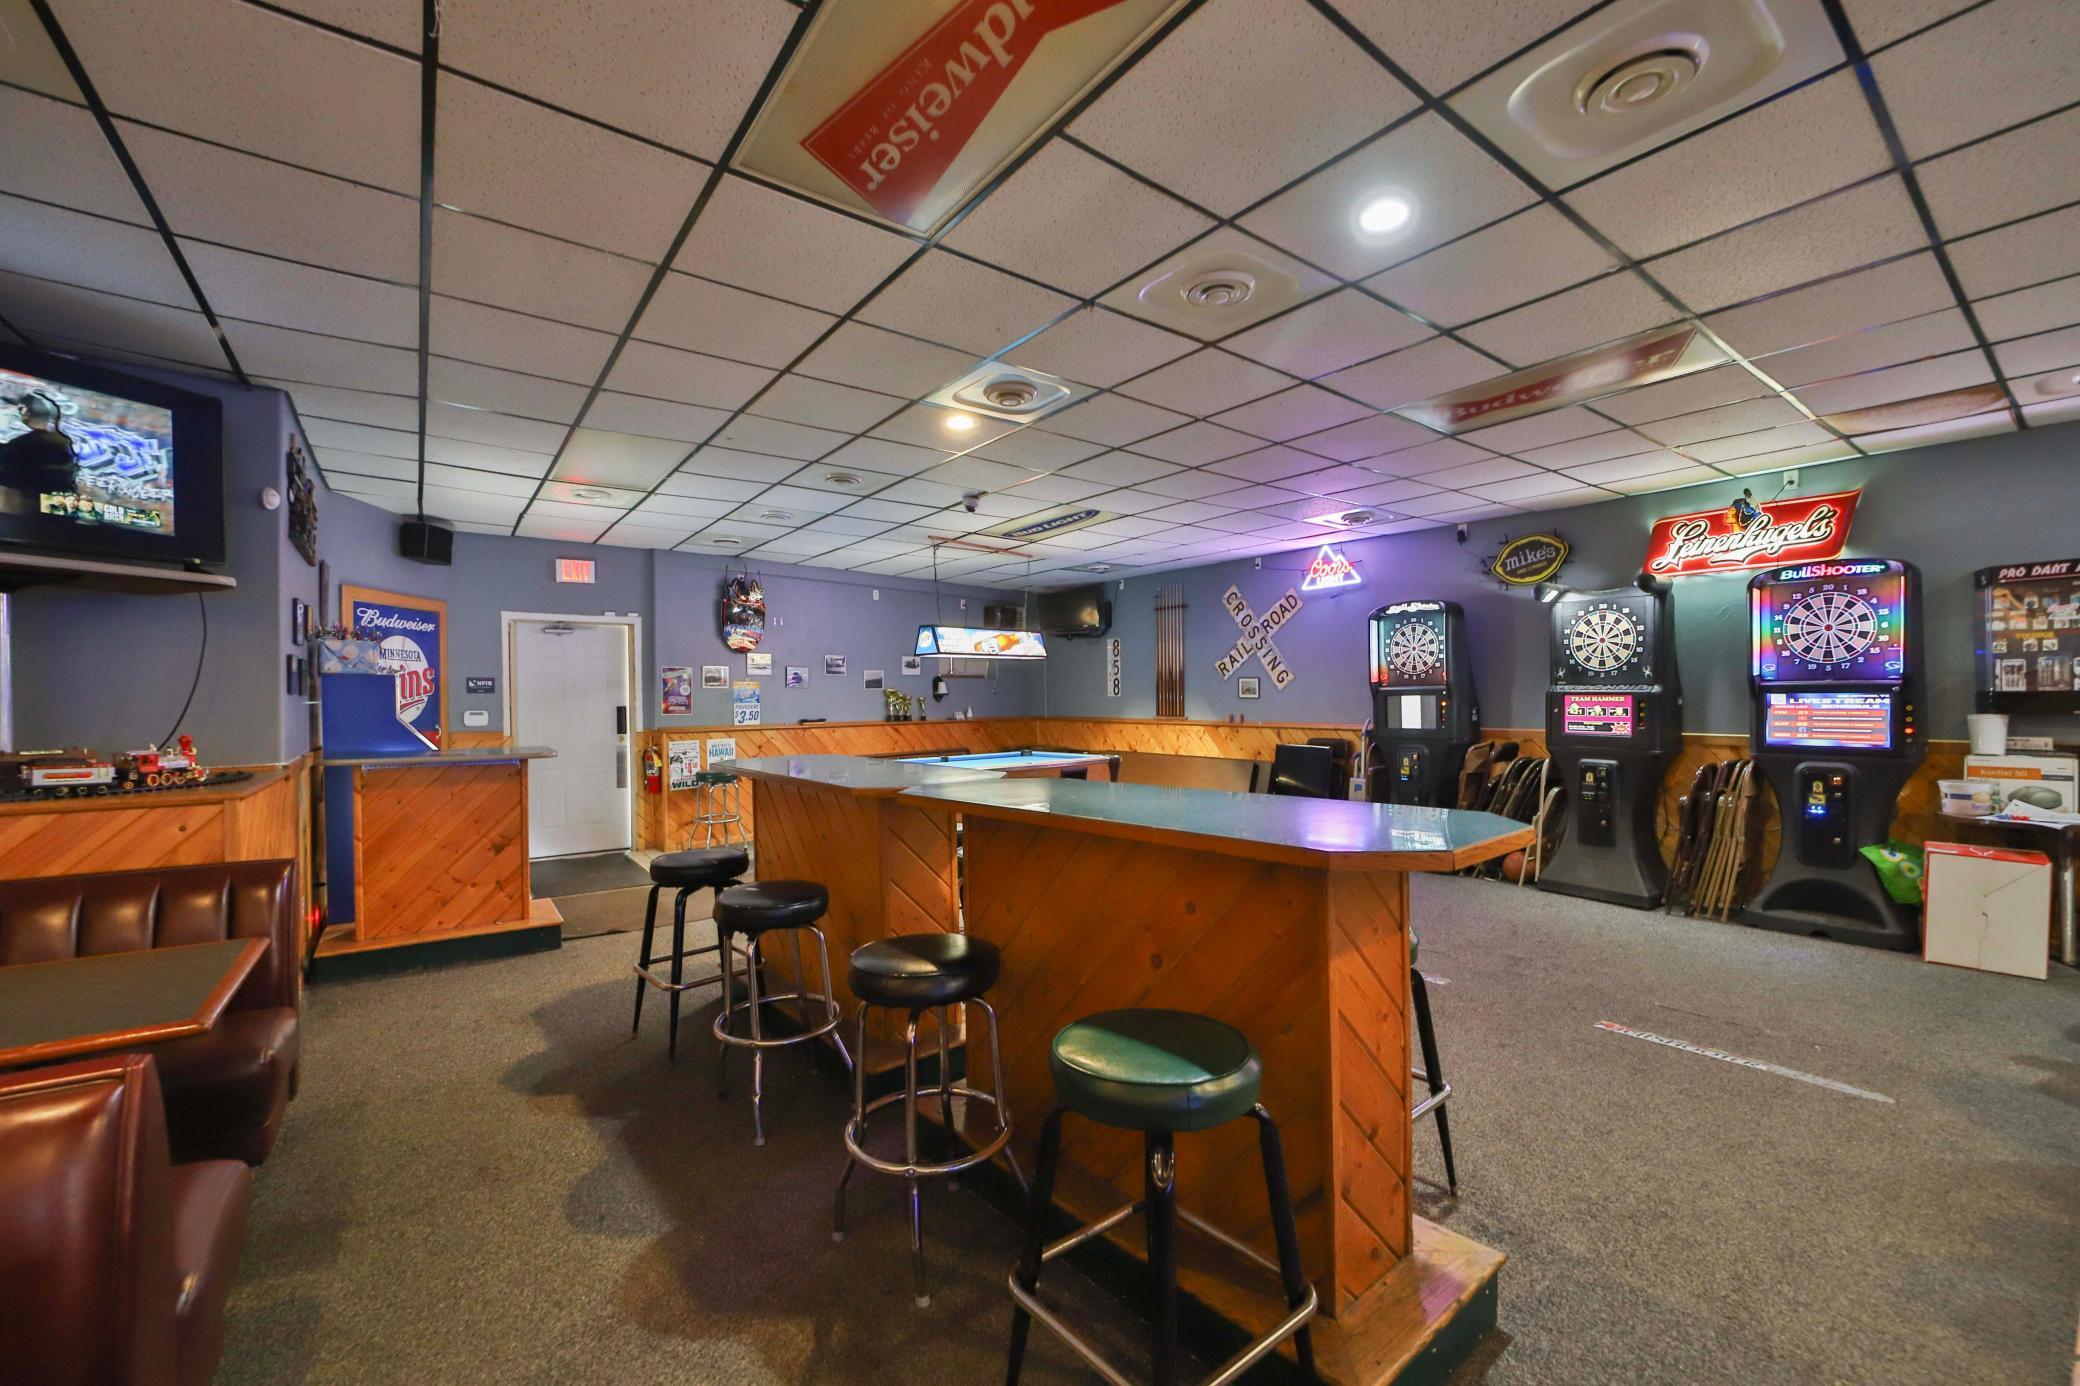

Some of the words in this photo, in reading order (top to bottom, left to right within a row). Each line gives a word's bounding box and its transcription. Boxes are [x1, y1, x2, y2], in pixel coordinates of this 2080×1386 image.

[1042, 511, 1087, 529] LIGHT
[1650, 504, 1841, 572] Leinenkugel's
[1310, 558, 1351, 578] Coors
[1505, 545, 1556, 572] mike's
[562, 559, 591, 581] EXIT
[1999, 567, 2025, 579] PRO
[2031, 563, 2071, 577] DART
[357, 607, 436, 632] Budweiser
[1226, 591, 1289, 684] CROSSING
[379, 648, 422, 662] MINNESOTA
[400, 664, 435, 700] ins
[735, 710, 760, 724] $3.50
[671, 779, 699, 789] WILD
